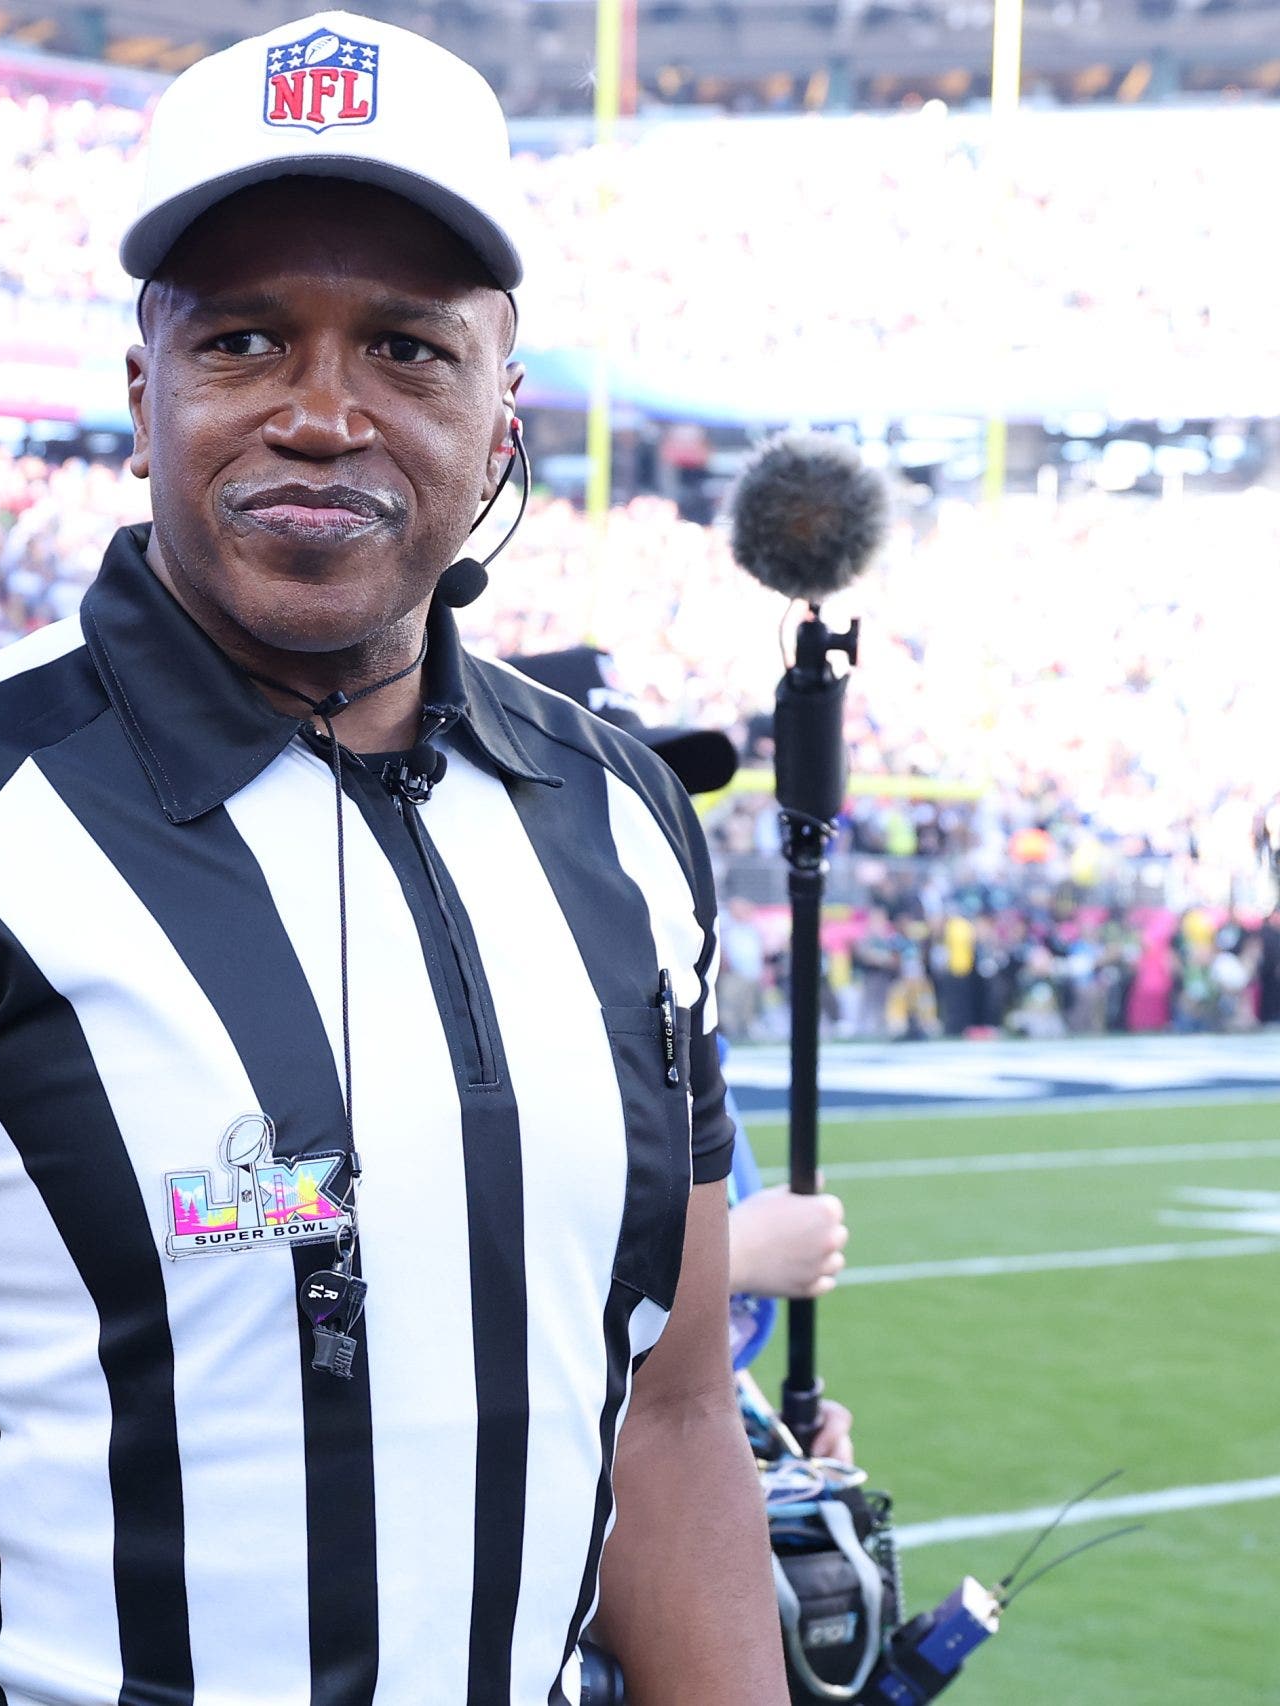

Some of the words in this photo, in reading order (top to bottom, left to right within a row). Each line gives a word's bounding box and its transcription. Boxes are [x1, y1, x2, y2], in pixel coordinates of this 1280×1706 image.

[269, 68, 368, 124] NFL
[666, 1037, 674, 1060] PILOT
[194, 1229, 264, 1246] SUPER
[273, 1221, 329, 1237] BOWL
[308, 1284, 325, 1299] 14
[324, 1289, 339, 1300] R
